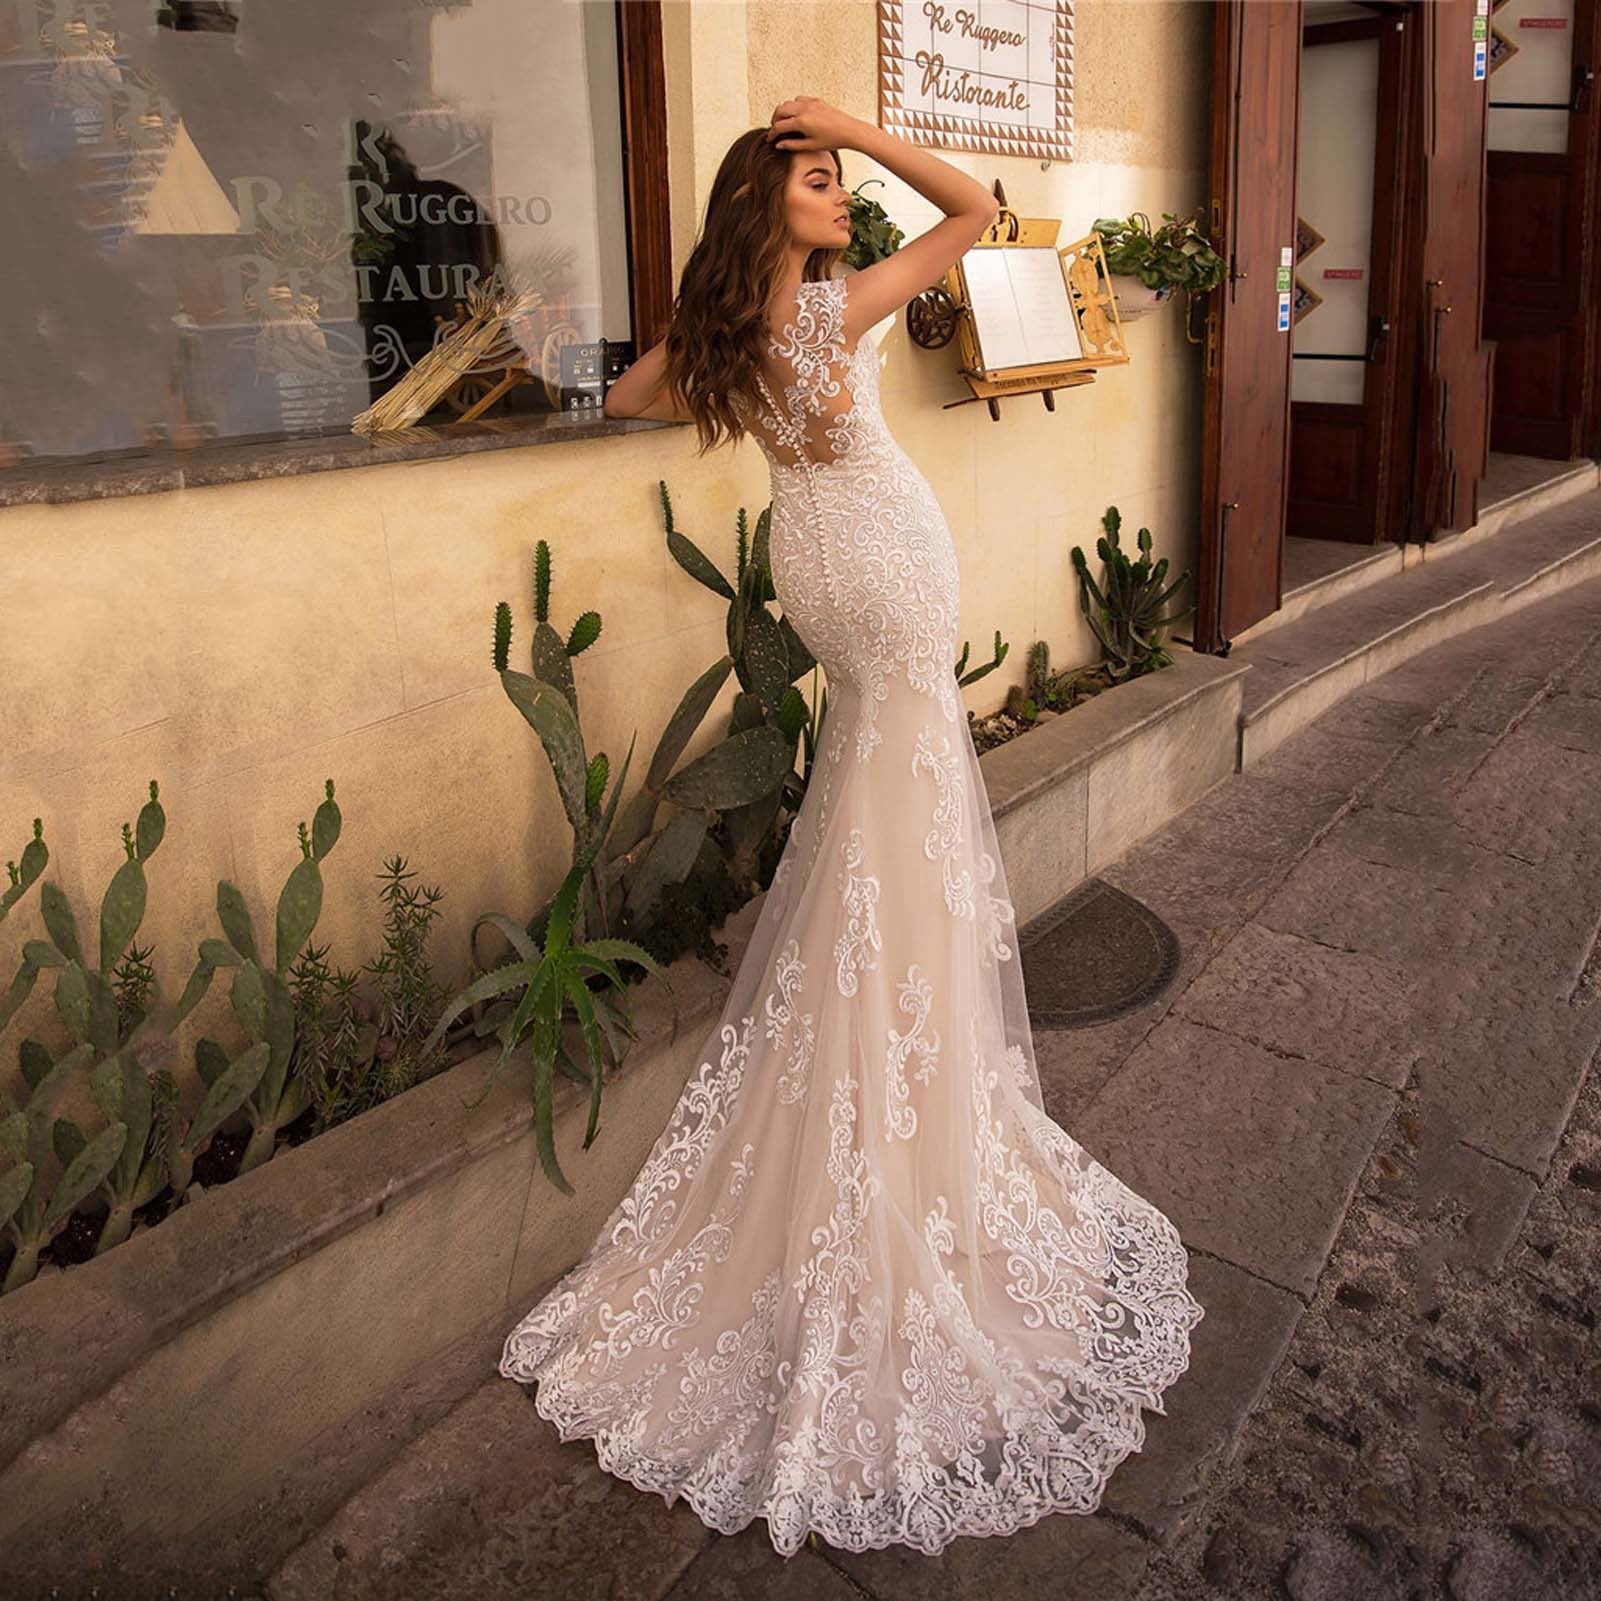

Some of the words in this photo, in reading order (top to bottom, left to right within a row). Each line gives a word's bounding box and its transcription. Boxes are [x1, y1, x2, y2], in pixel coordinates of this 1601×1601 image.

[922, 1, 954, 34] Re
[955, 9, 1027, 51] Ruggero
[915, 50, 1031, 111] Ristorante
[342, 179, 552, 234] RUGGERO
